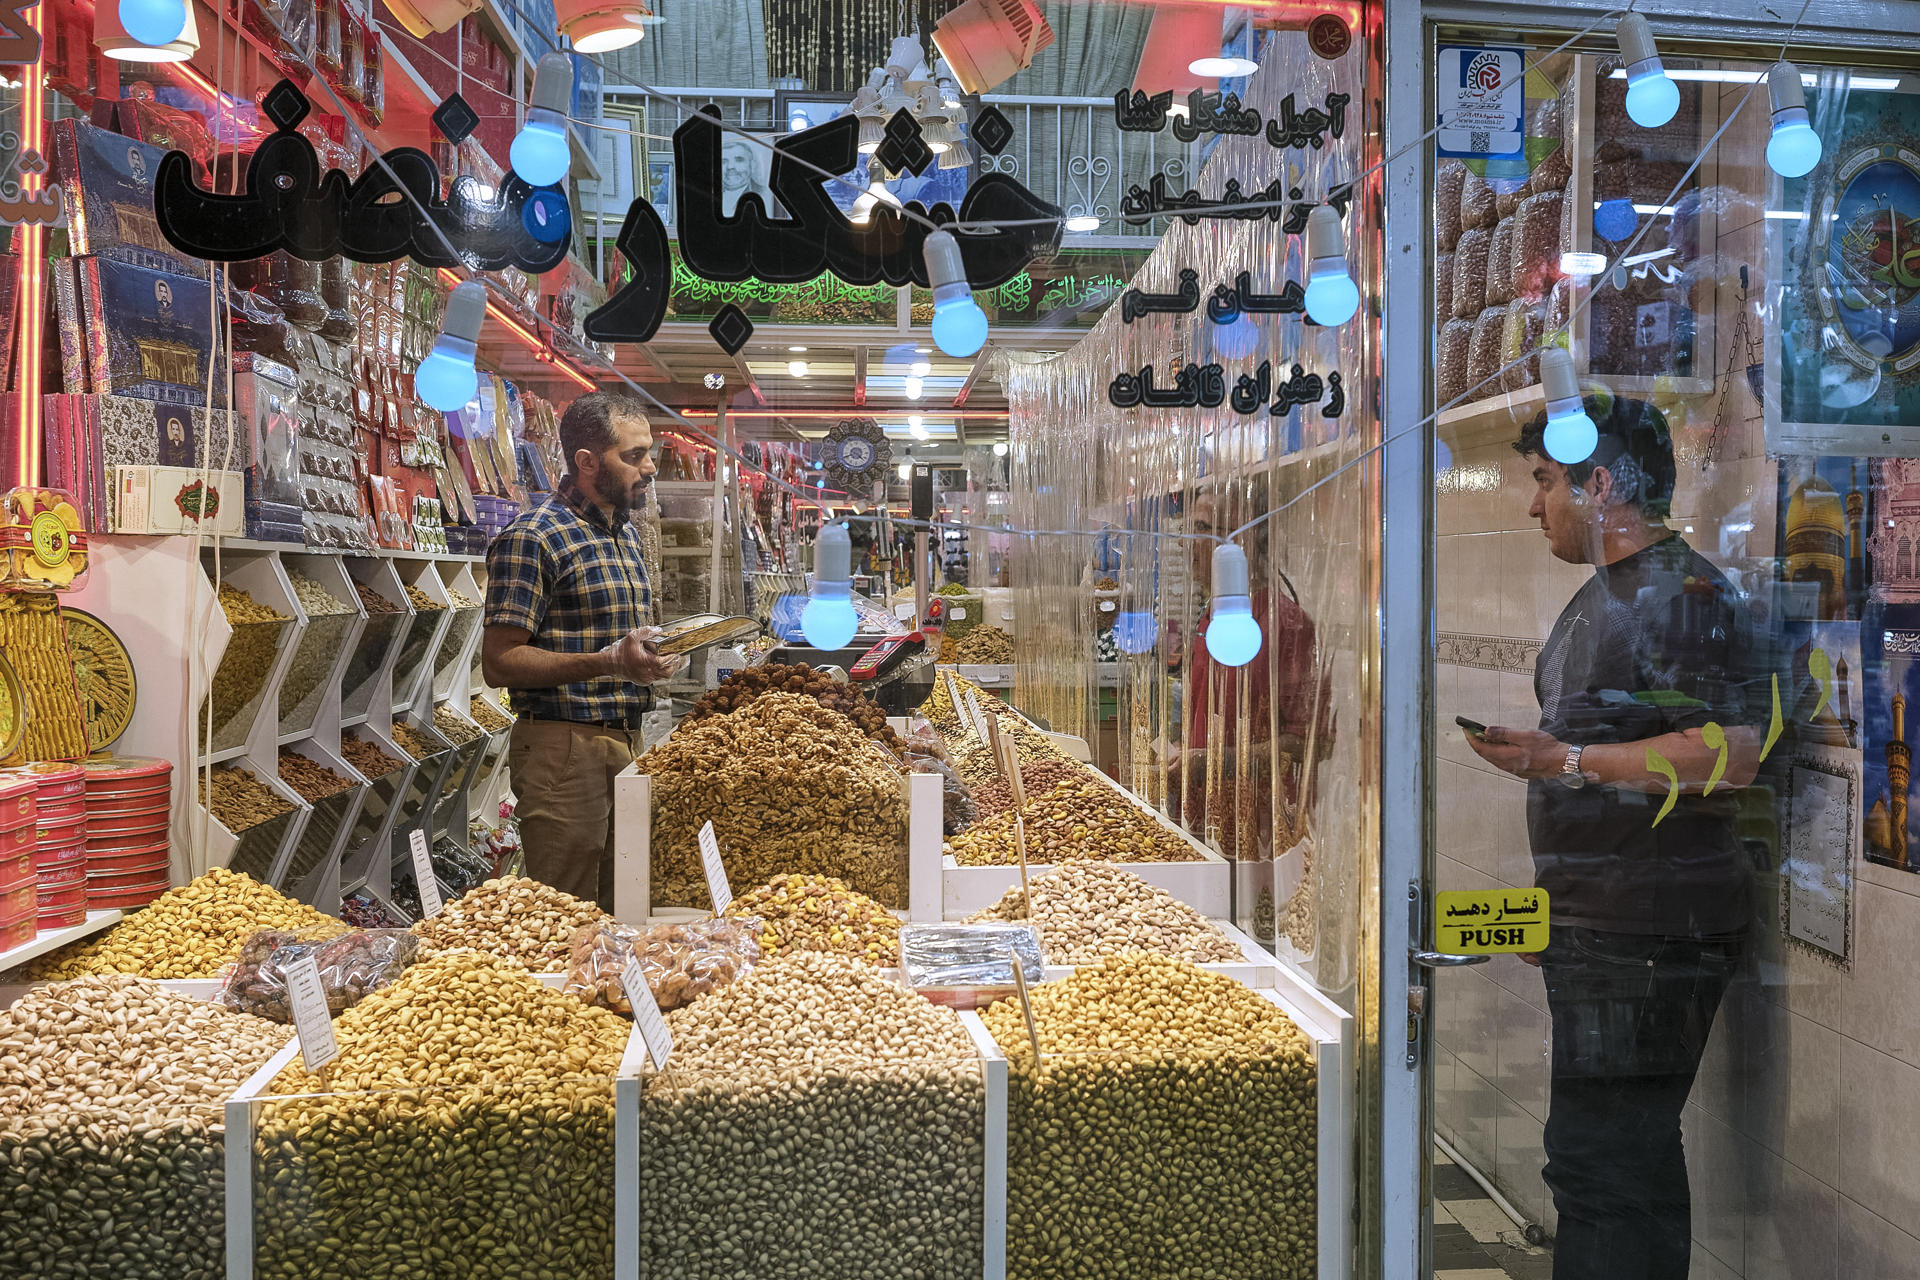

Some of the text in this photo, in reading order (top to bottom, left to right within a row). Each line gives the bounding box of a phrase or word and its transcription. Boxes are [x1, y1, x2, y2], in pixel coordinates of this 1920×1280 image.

[1114, 87, 1350, 149] آجیل مشکل گشا
[154, 78, 1064, 356] خشکبار منصف
[1120, 173, 1282, 226] اصفهان
[1121, 268, 1316, 325] هان قم
[1231, 360, 1345, 417] زعفران
[1495, 894, 1539, 921] فشار
[1460, 928, 1525, 947] PUSH
